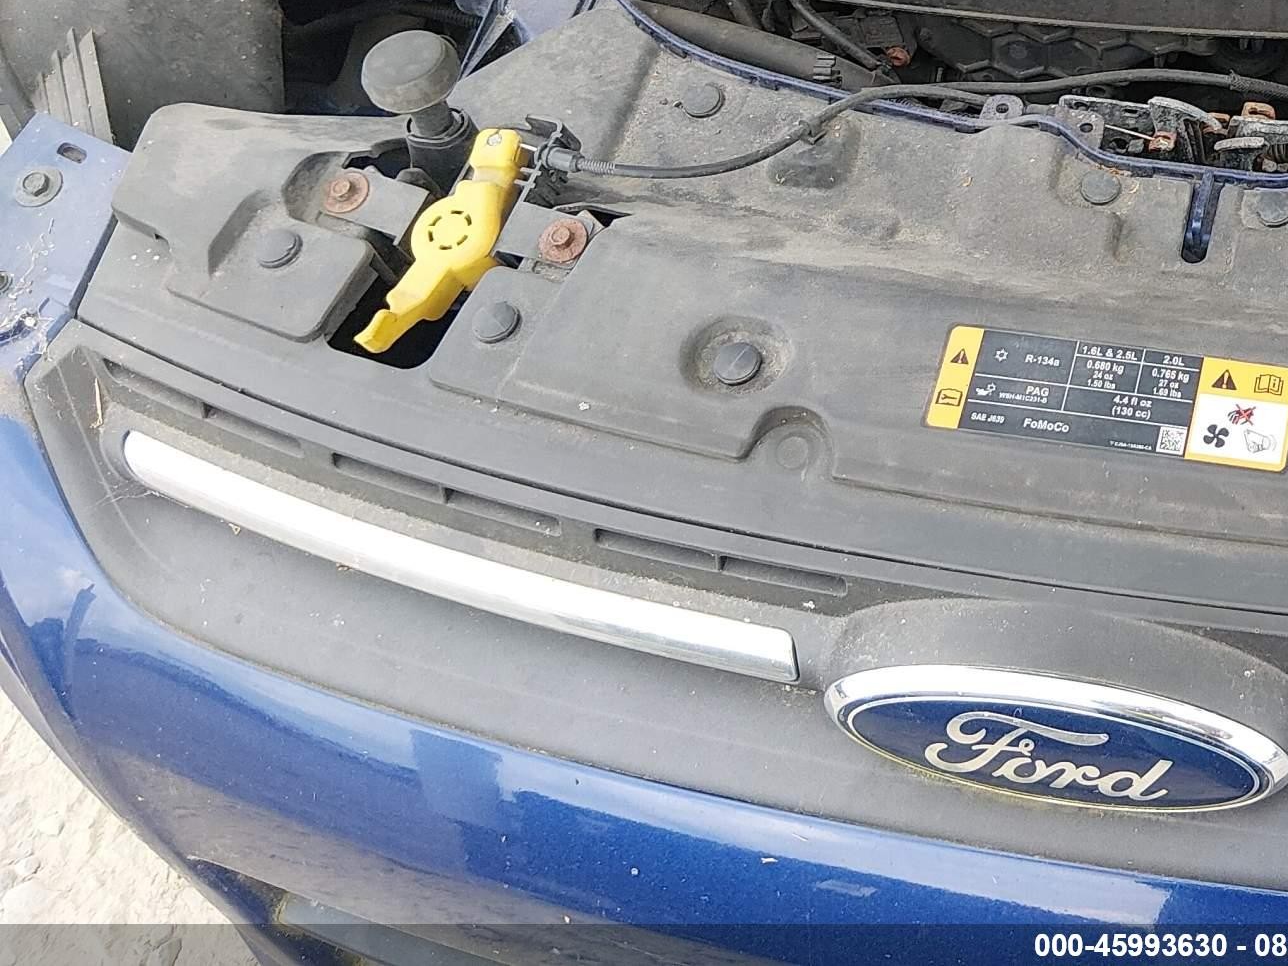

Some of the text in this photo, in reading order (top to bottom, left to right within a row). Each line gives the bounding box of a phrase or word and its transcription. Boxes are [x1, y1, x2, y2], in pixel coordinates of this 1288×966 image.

[1024, 353, 1060, 367] R-134a
[1082, 345, 1138, 361] 1.6L & 2.5L
[1086, 360, 1125, 375] 0.680 kg
[1162, 355, 1185, 366] 2.0L
[1092, 370, 1114, 381] 24 oz
[1151, 368, 1190, 383] 0.765 kg
[1087, 379, 1103, 388] 1.50
[1158, 379, 1168, 388] 27
[1025, 385, 1050, 397] PAG
[1113, 394, 1153, 408] 4.4 fl oz
[1111, 404, 1152, 421] (130 cc)
[1023, 417, 1071, 433] FoMoCo
[924, 710, 1175, 801] Ford
